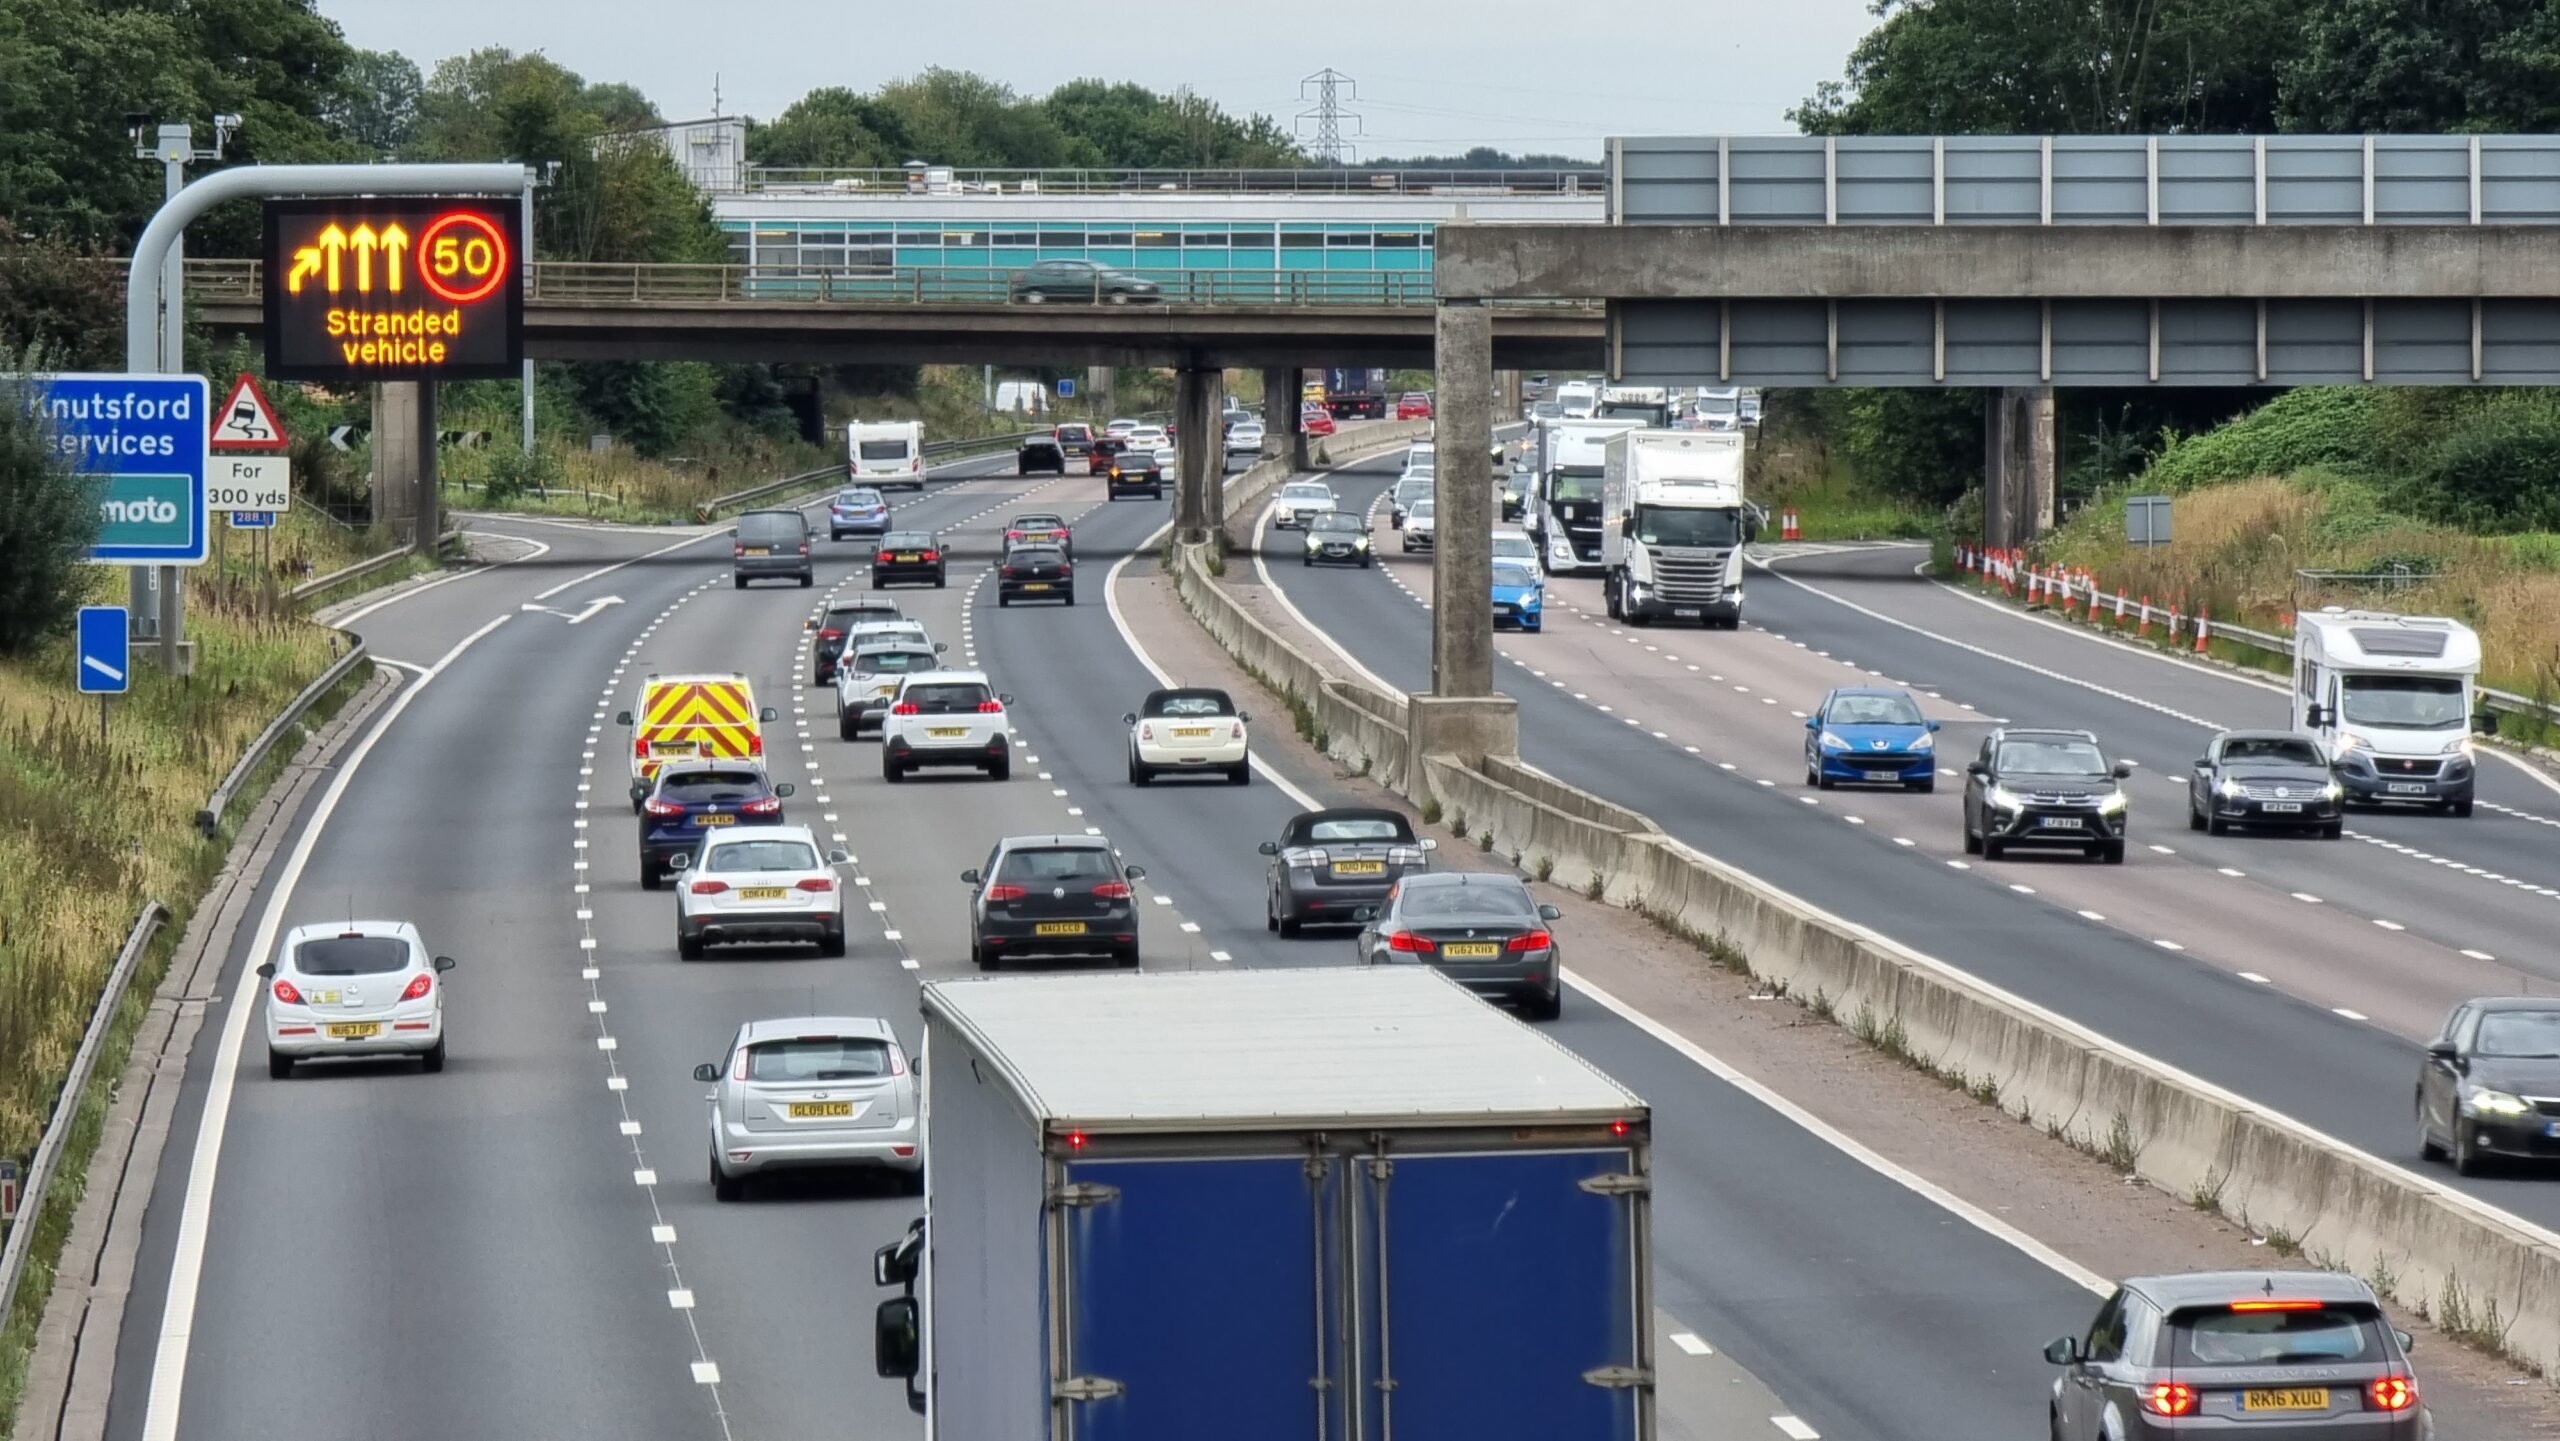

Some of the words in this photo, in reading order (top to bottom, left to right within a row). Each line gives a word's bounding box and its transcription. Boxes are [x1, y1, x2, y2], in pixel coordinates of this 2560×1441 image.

[434, 237, 492, 276] 50
[326, 308, 460, 336] Stranded
[342, 337, 446, 364] vehicle
[45, 428, 175, 456] services
[232, 463, 262, 479] For
[99, 496, 177, 523] moto
[208, 488, 248, 504] 300
[255, 489, 287, 507] yds
[794, 1104, 825, 1118] GL09
[2250, 1392, 2287, 1408] RK16
[2290, 1390, 2322, 1406] XUO
